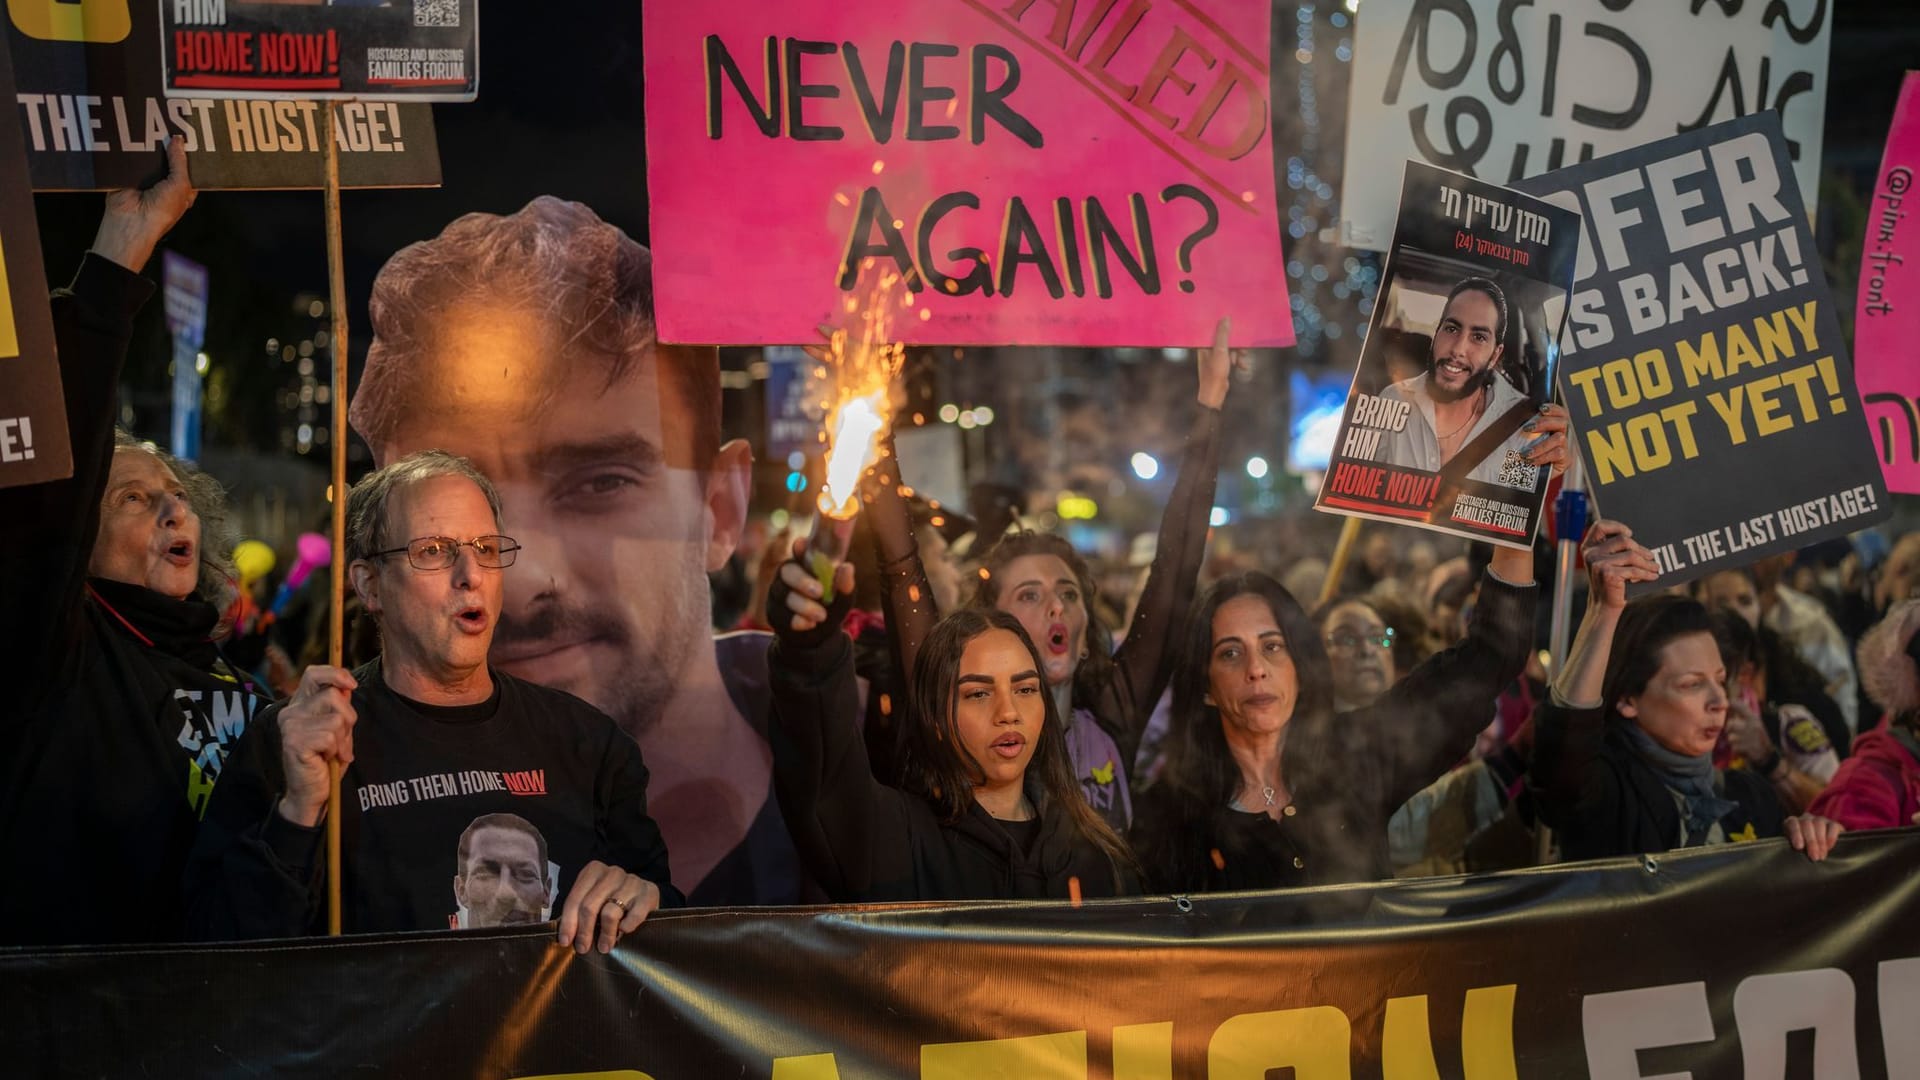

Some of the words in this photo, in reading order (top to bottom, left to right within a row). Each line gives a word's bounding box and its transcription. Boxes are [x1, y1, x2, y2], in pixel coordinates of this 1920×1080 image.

[174, 30, 253, 73] HOME
[259, 28, 340, 74] NOW!
[367, 47, 410, 61] HOSTAGES
[410, 48, 427, 61] AND
[428, 48, 464, 61] MISSING
[368, 61, 422, 80] FAMILIES
[423, 62, 465, 80] FORUM
[703, 35, 1045, 149] NEVER
[16, 93, 110, 152] THE
[112, 97, 216, 152] LAST
[225, 99, 405, 152] HOSTAGE!
[1440, 185, 1462, 219] חי
[1464, 193, 1512, 233] עדיין
[835, 183, 1219, 299] AGAIN?
[1455, 230, 1474, 253] (24)
[1514, 208, 1550, 246] מתן
[1512, 249, 1530, 266] מתן
[1617, 225, 1809, 335] BACK!
[1569, 348, 1674, 418] TOO
[1675, 300, 1820, 389] MANY
[1351, 393, 1411, 432] BRING
[1586, 400, 1699, 485] NOT
[1706, 356, 1847, 446] YET!
[1341, 427, 1382, 461] HIM
[1331, 462, 1387, 500] HOME
[1384, 471, 1442, 508] NOW!
[1452, 503, 1492, 525] FAMILIES
[1493, 512, 1528, 533] FORUM
[1456, 494, 1489, 509] HOSTAGES
[1487, 499, 1501, 511] AND
[1500, 502, 1530, 518] MISSING
[1683, 529, 1727, 565] THE
[1725, 513, 1776, 551] LAST
[1777, 484, 1878, 536] HOSTAGE!
[357, 781, 410, 812] BRING
[409, 773, 456, 801] THEM
[457, 770, 507, 796] HOME
[502, 769, 546, 794] NOW
